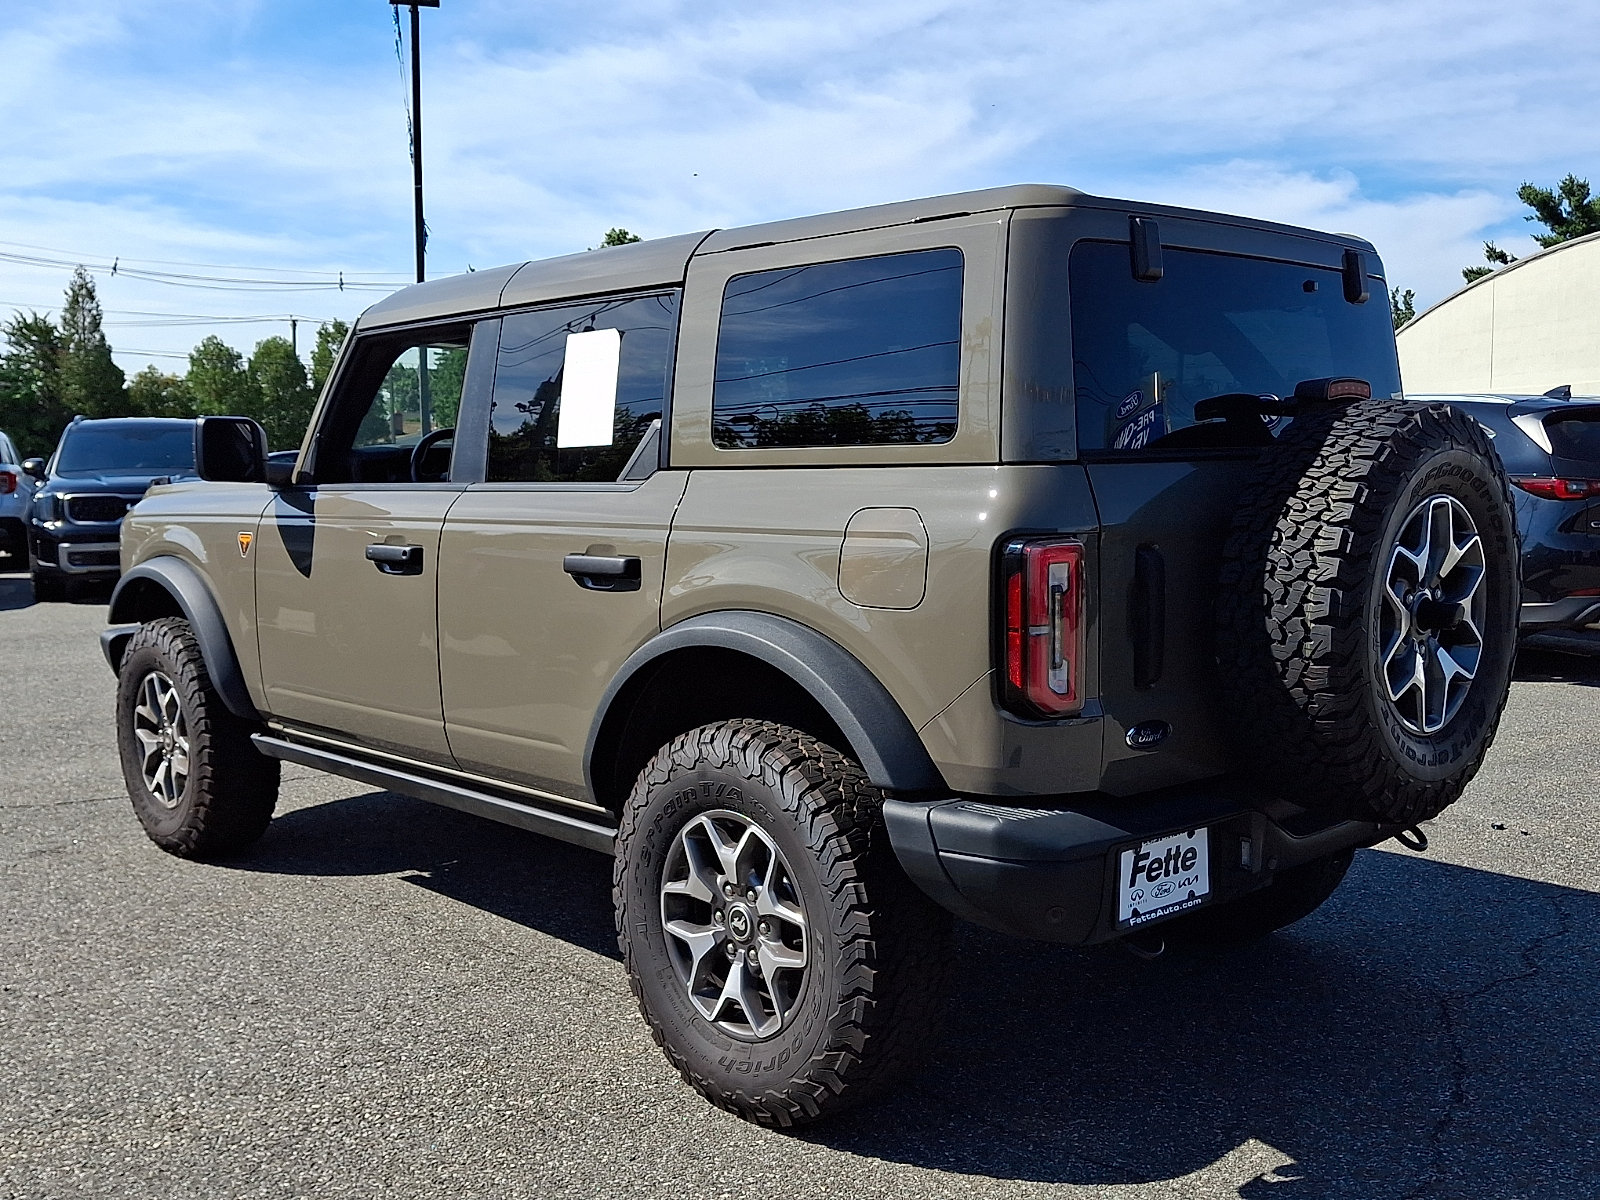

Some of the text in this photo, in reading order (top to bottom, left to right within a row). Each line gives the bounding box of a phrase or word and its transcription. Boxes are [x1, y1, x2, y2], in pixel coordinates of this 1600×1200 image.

[699, 781, 744, 804] T/A
[1129, 845, 1198, 888] Fette
[1130, 898, 1202, 926] FetteAuto.com
